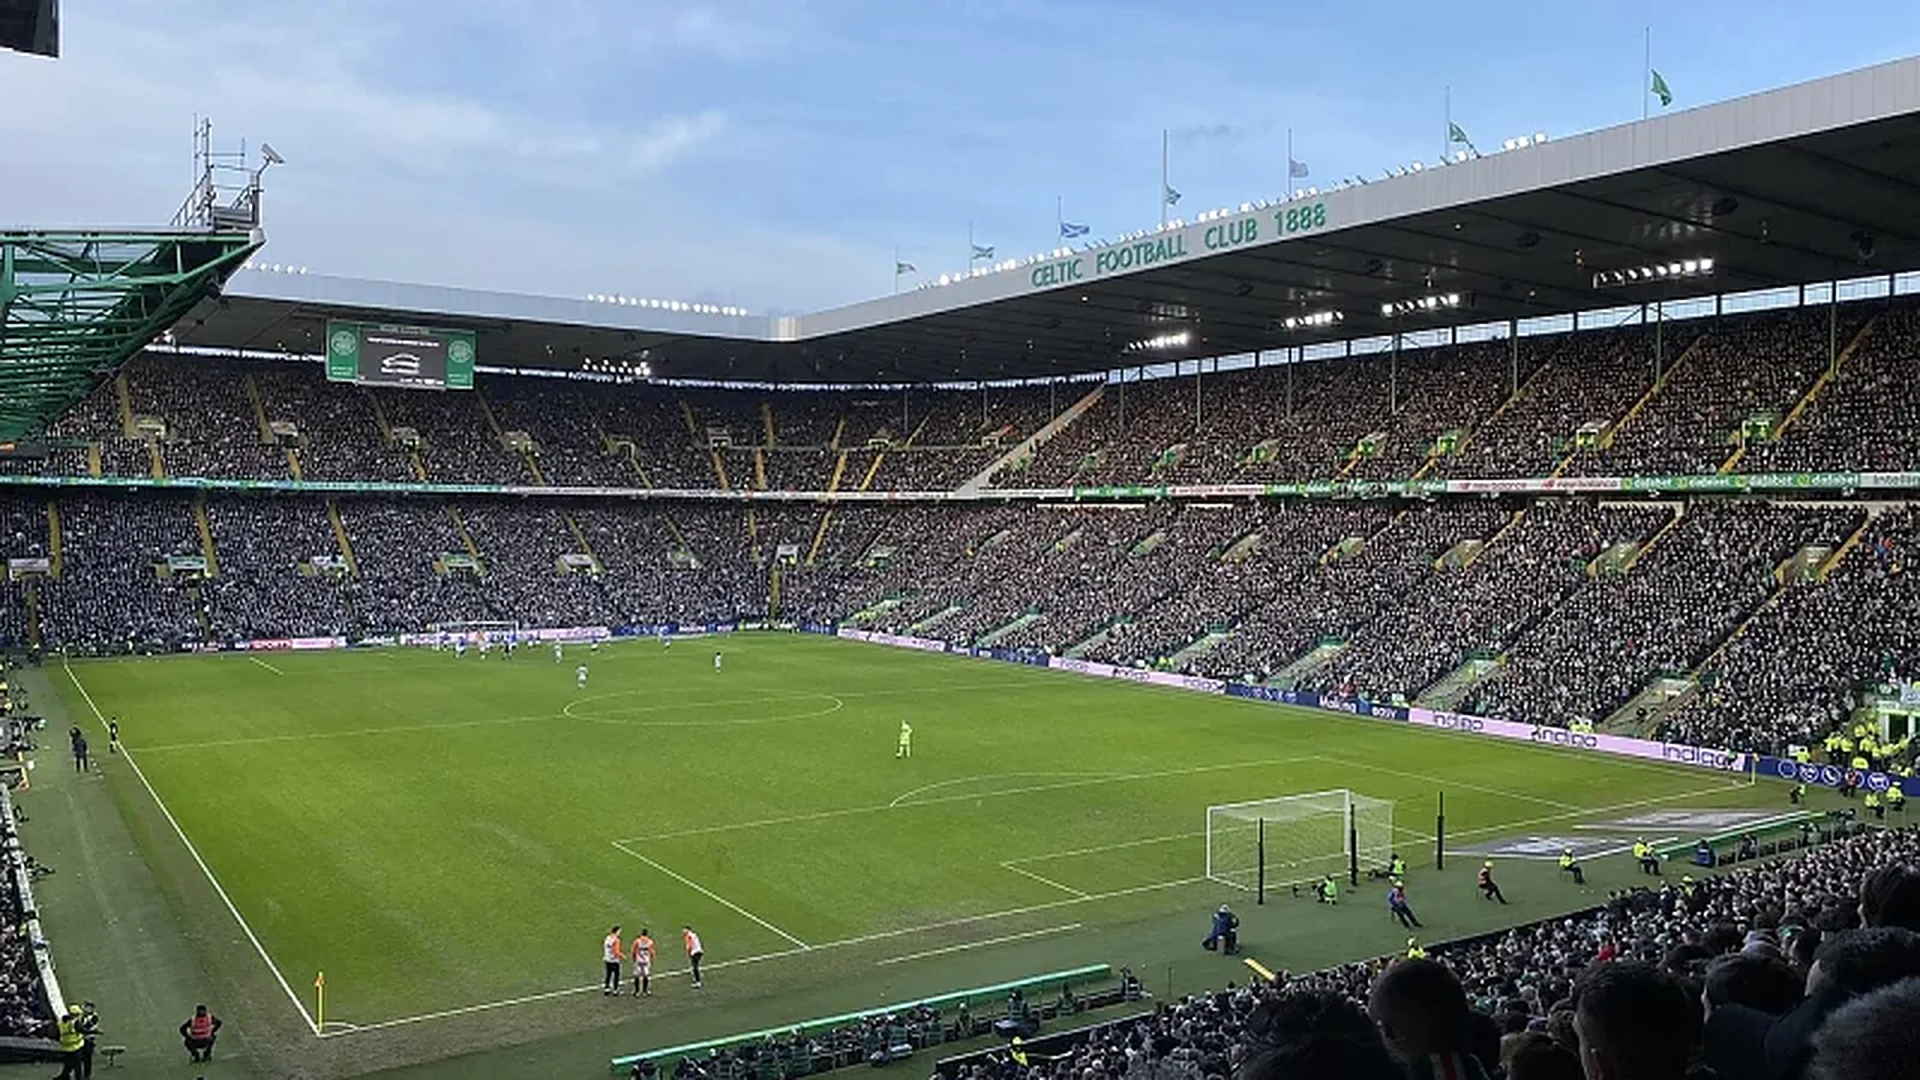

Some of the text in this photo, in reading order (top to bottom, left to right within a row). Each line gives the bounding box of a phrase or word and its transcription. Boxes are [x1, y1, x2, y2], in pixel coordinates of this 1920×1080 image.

[1032, 203, 1326, 287] CELTIC FOOTBALL CLUB 1888
